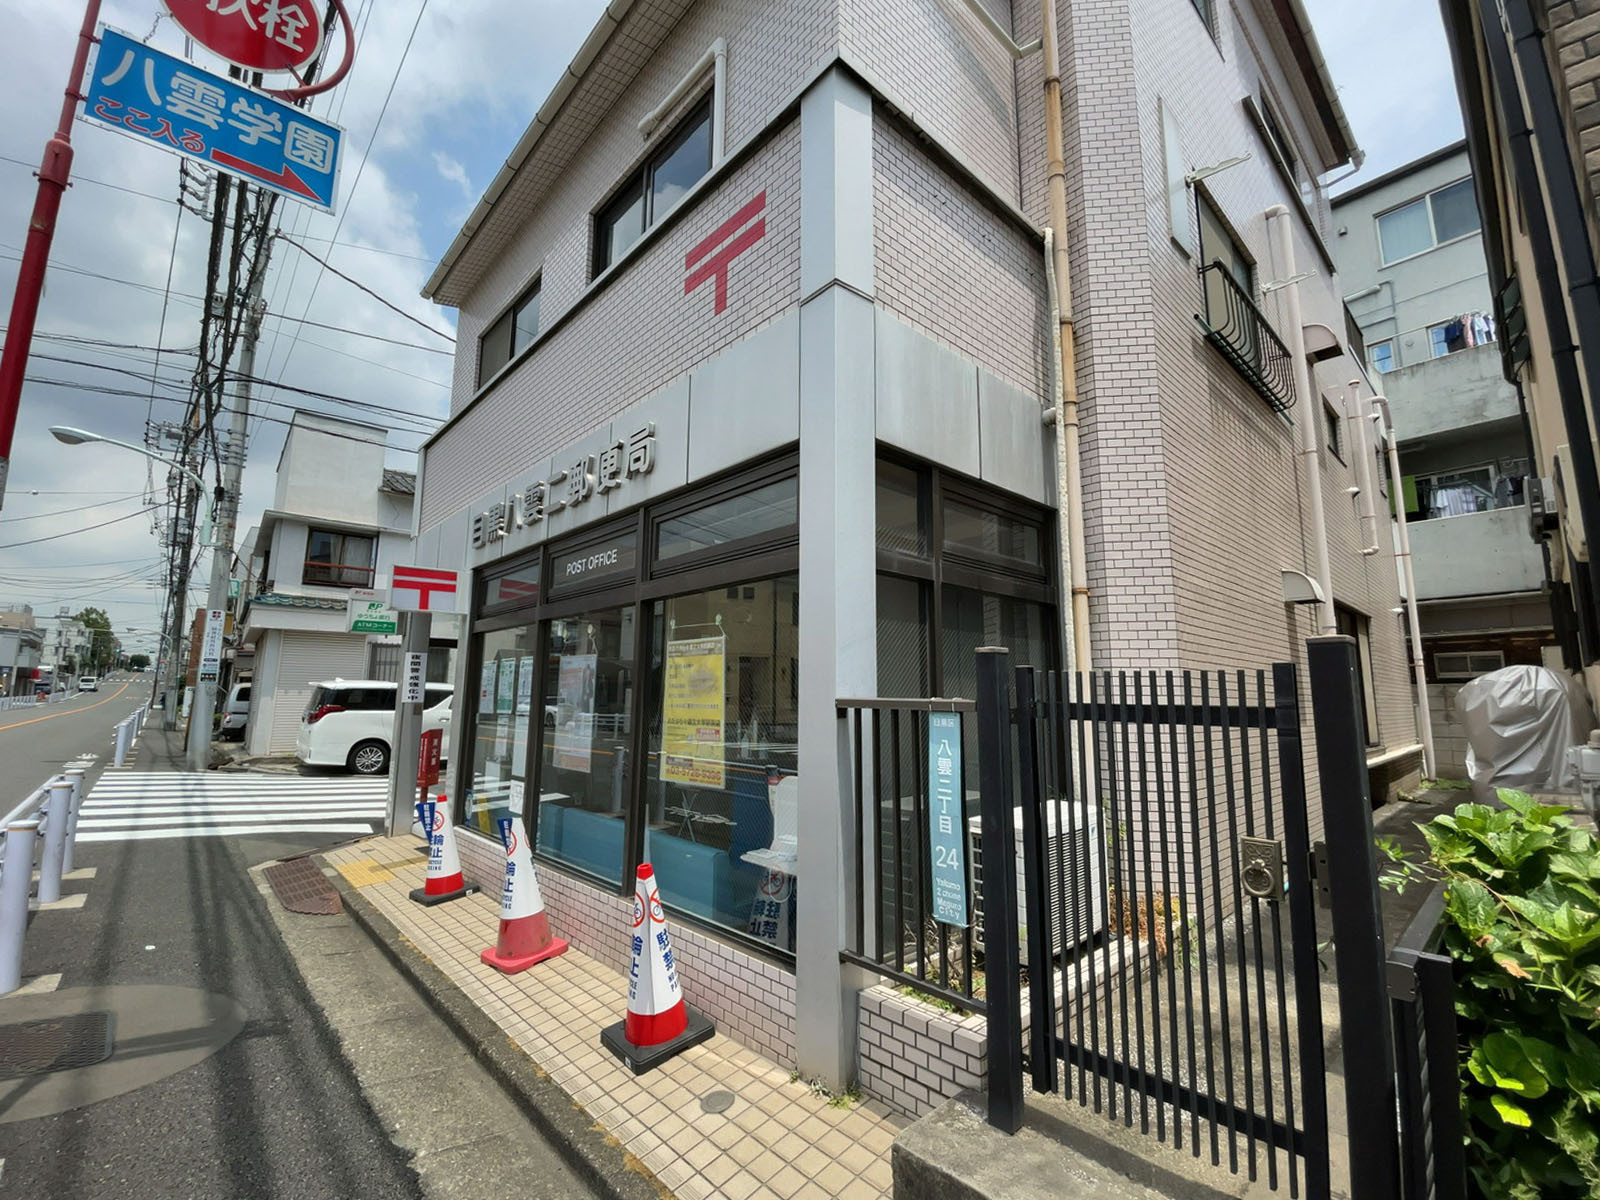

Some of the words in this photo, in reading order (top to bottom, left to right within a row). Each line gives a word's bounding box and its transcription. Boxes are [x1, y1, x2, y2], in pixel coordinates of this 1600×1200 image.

[206, 0, 310, 53] 火栓
[94, 97, 205, 153] ここ入る
[101, 49, 335, 175] 八雲学園
[472, 421, 656, 550] 目黒八雲二郵便局
[566, 559, 587, 576] POST
[588, 549, 618, 570] OFFICE
[936, 738, 953, 835] 八雲二丁目
[935, 845, 960, 871] 24
